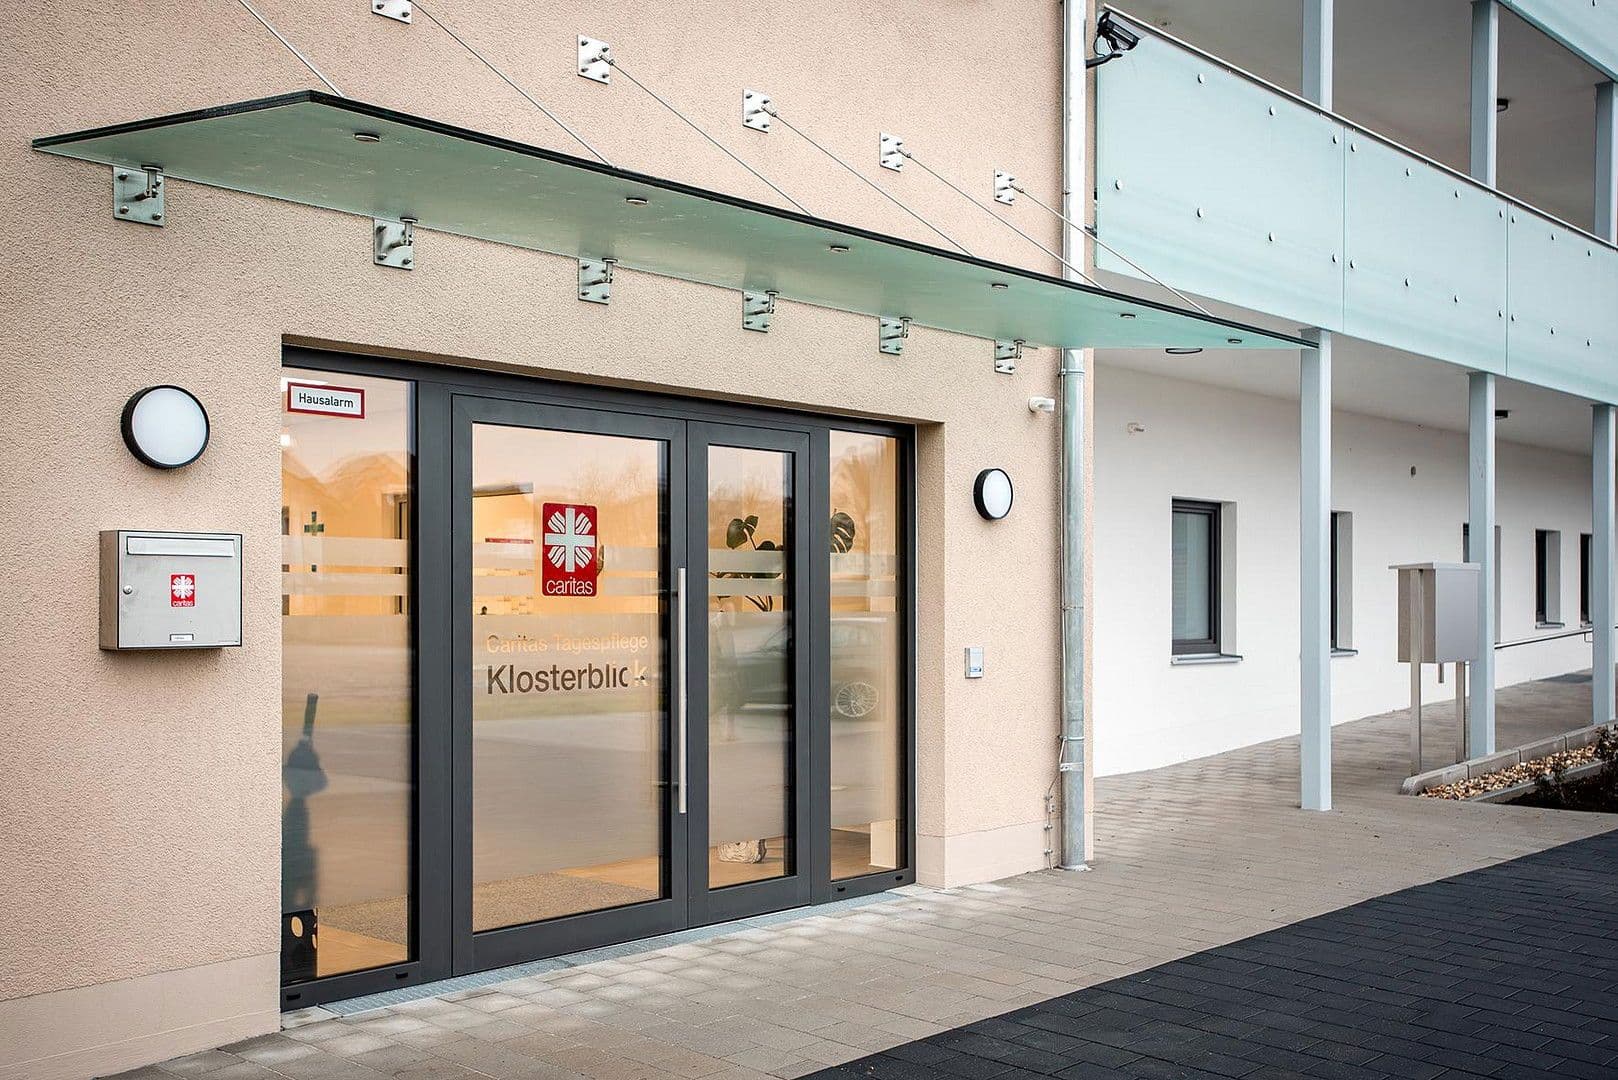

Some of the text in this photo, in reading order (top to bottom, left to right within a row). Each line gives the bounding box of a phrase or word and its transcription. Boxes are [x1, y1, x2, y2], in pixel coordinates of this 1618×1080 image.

[298, 392, 354, 408] Hausalarm
[546, 576, 593, 595] caritas
[486, 633, 649, 655] Caritas Tagespflege
[487, 660, 649, 694] Klosterblick
